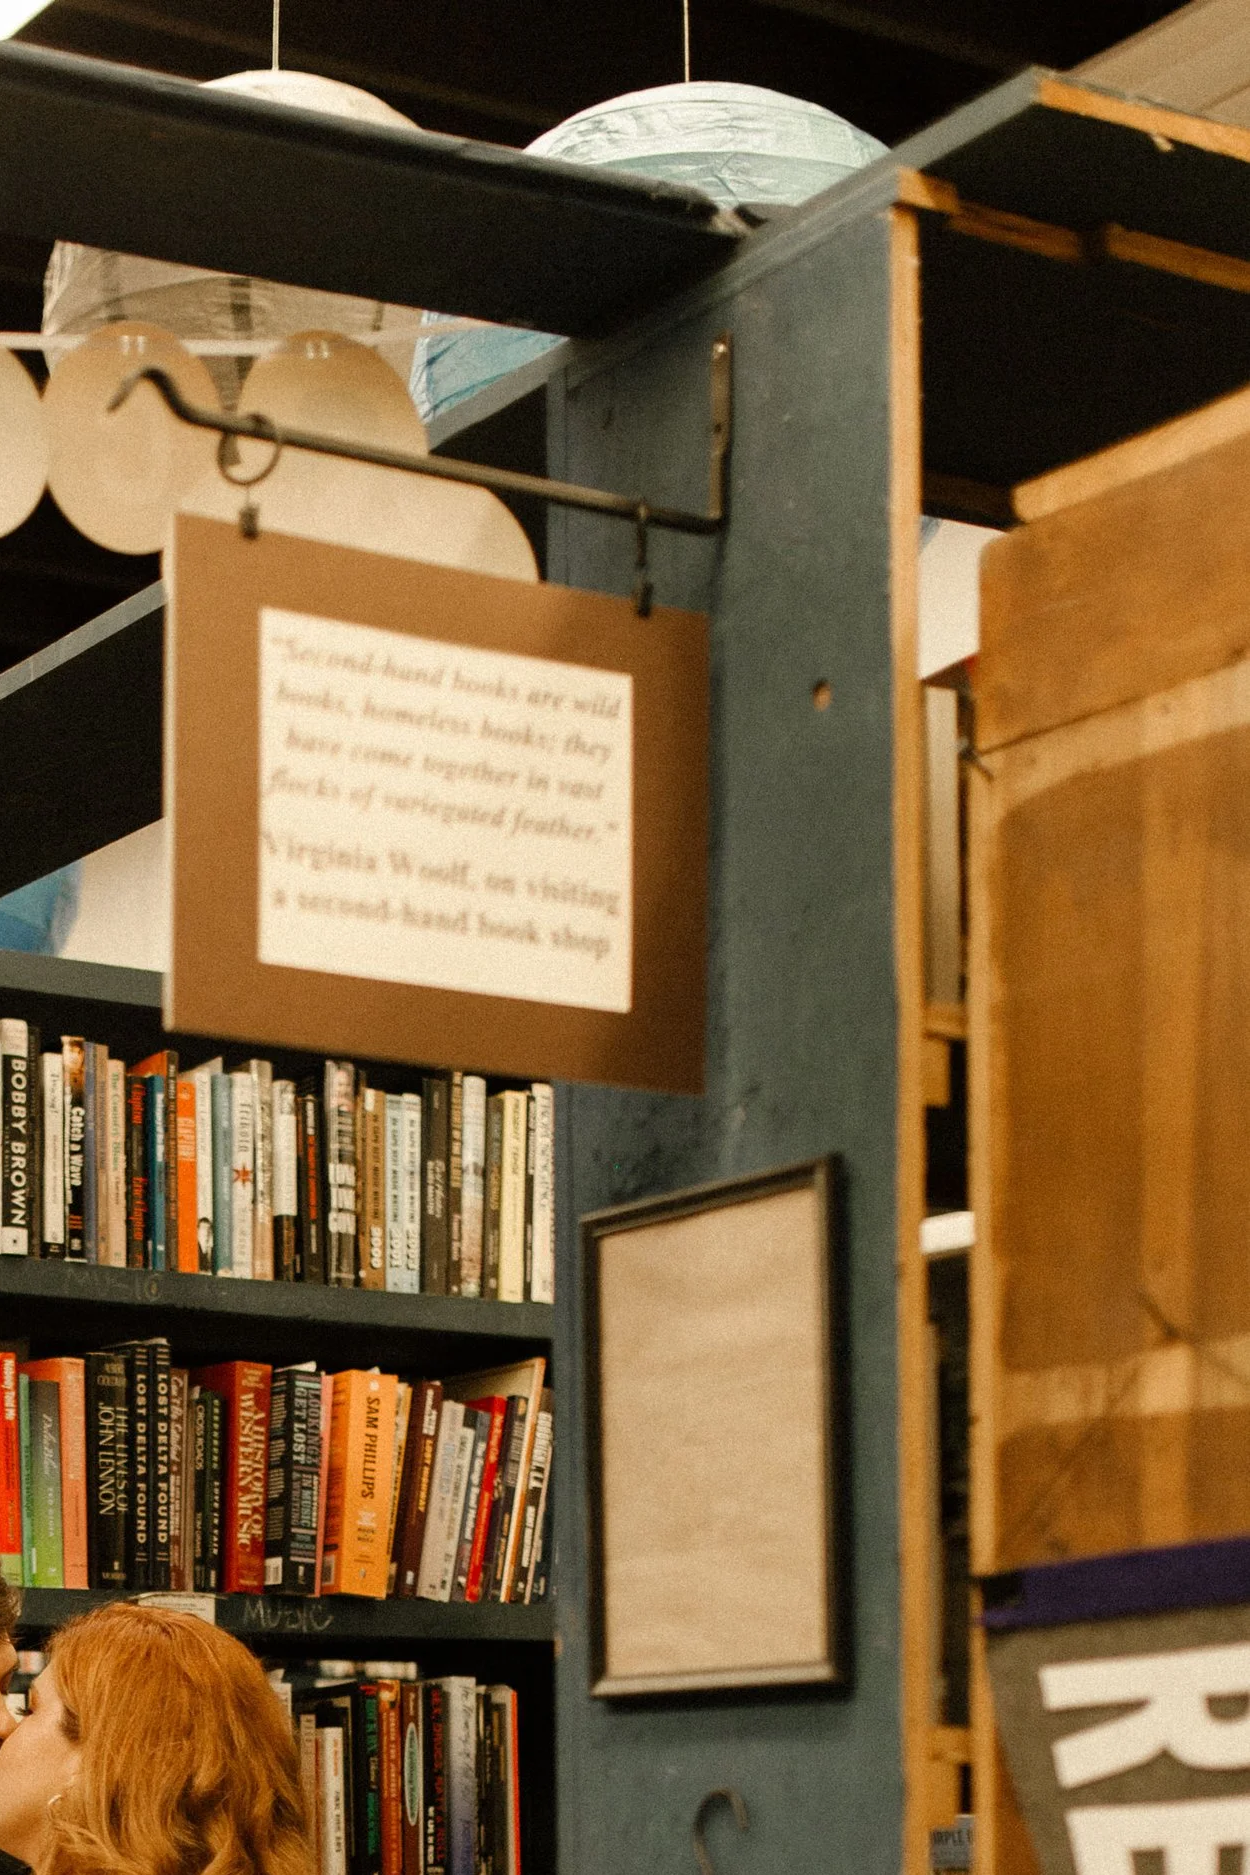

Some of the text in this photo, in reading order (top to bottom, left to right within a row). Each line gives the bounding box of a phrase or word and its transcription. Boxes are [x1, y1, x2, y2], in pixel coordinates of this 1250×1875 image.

[362, 696, 471, 737] homeless
[564, 731, 613, 766] they
[573, 692, 622, 721] wild
[286, 728, 342, 757] have
[350, 746, 414, 770] come
[423, 754, 518, 790] together
[527, 768, 549, 791] in
[265, 767, 341, 800] flocks
[349, 784, 376, 814] of
[384, 795, 507, 830] variegated
[261, 831, 378, 877] Virginia
[485, 872, 515, 895] on
[526, 872, 622, 917] visiting
[273, 888, 612, 963] a second-hand book shop
[109, 1072, 122, 1171] The Country Blues
[128, 1083, 145, 1124] Clapton
[10, 1059, 28, 1225] BOBBY BROWN
[70, 1106, 85, 1186] Catch a Wave
[372, 1125, 380, 1144] CAPO
[372, 1146, 380, 1162] BEST
[391, 1129, 399, 1147] CAPO
[391, 1150, 399, 1167] BEST
[408, 1130, 416, 1149] CAPO
[408, 1151, 416, 1168] BEST
[372, 1166, 380, 1186] MUSIC
[391, 1170, 399, 1190] MUSIC
[408, 1171, 416, 1191] MUSIC
[129, 1200, 146, 1241] Clapton
[372, 1191, 380, 1219] WRITING
[391, 1194, 399, 1223] WRITING
[408, 1195, 416, 1224] WRITING
[369, 1226, 382, 1269] 2000
[389, 1227, 402, 1269] 2001
[195, 1405, 205, 1470] CROSS ROADS
[292, 1387, 307, 1464] GET LOST
[306, 1389, 321, 1452] LOOKING
[98, 1403, 116, 1516] JOHN LENNON
[116, 1407, 130, 1514] THE LIVES OF
[136, 1374, 147, 1543] LOST DELTA FOUND
[157, 1373, 168, 1543] LOST DELTA FOUND
[236, 1393, 254, 1552] WESTERN MUSIC
[251, 1410, 266, 1539] A HISTORY OF
[361, 1396, 381, 1500] SAM PHILLIPS
[301, 1474, 312, 1528] IN MUSIC
[417, 1440, 434, 1513] LOST HIGHWAY
[213, 1512, 219, 1524] IN
[243, 1600, 334, 1632] MUSIC
